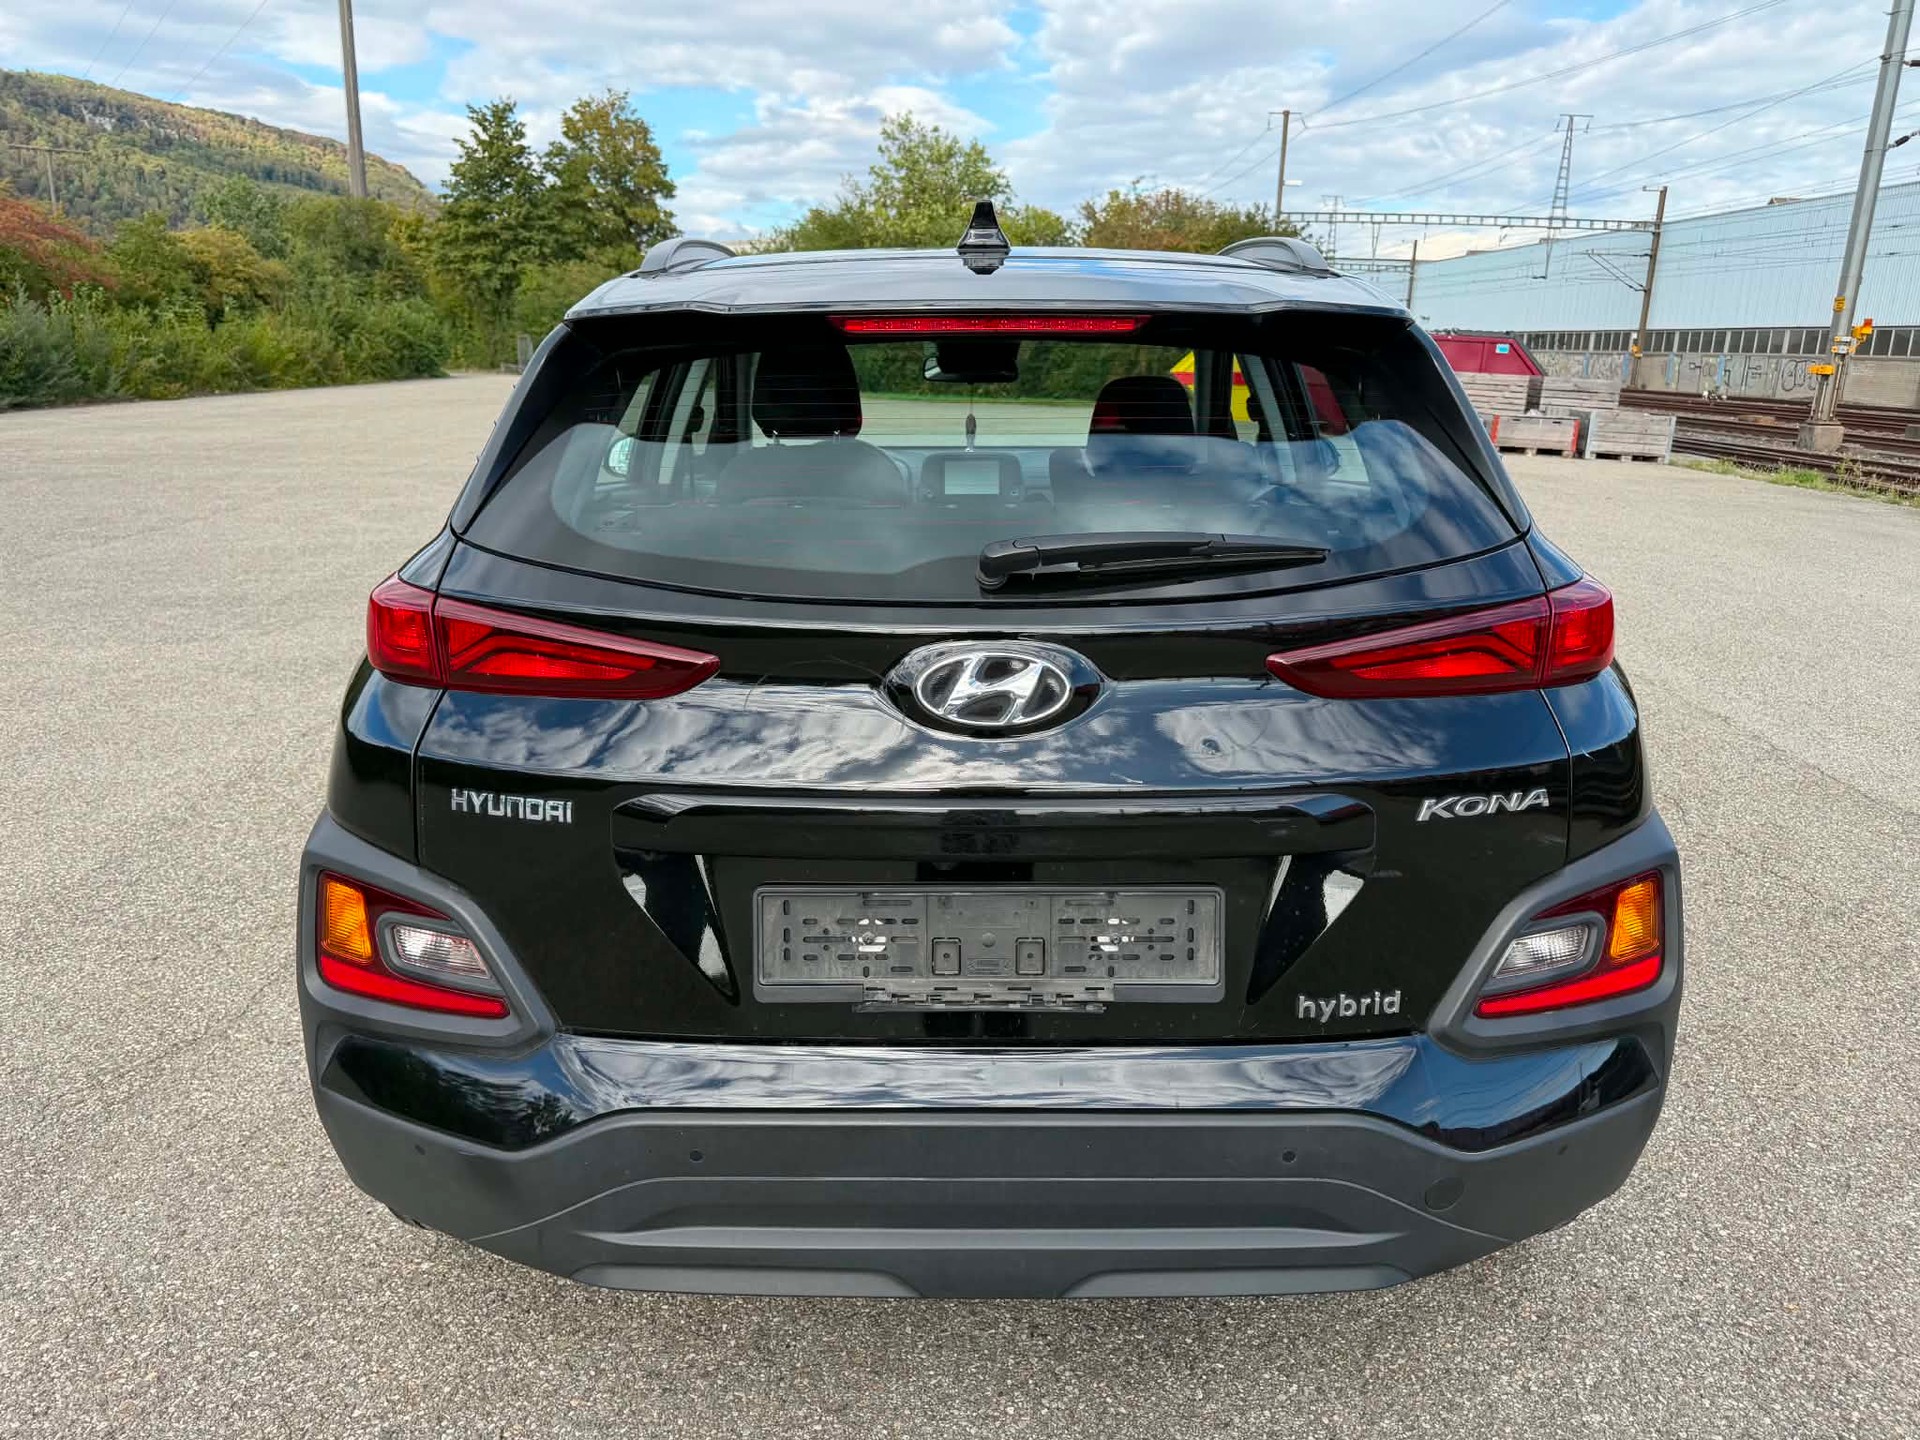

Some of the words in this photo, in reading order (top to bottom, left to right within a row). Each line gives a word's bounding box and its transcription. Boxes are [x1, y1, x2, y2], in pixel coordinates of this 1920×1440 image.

[451, 788, 573, 824] HYUNDAI
[1416, 788, 1550, 822] KONA
[1298, 989, 1402, 1024] hybrid
